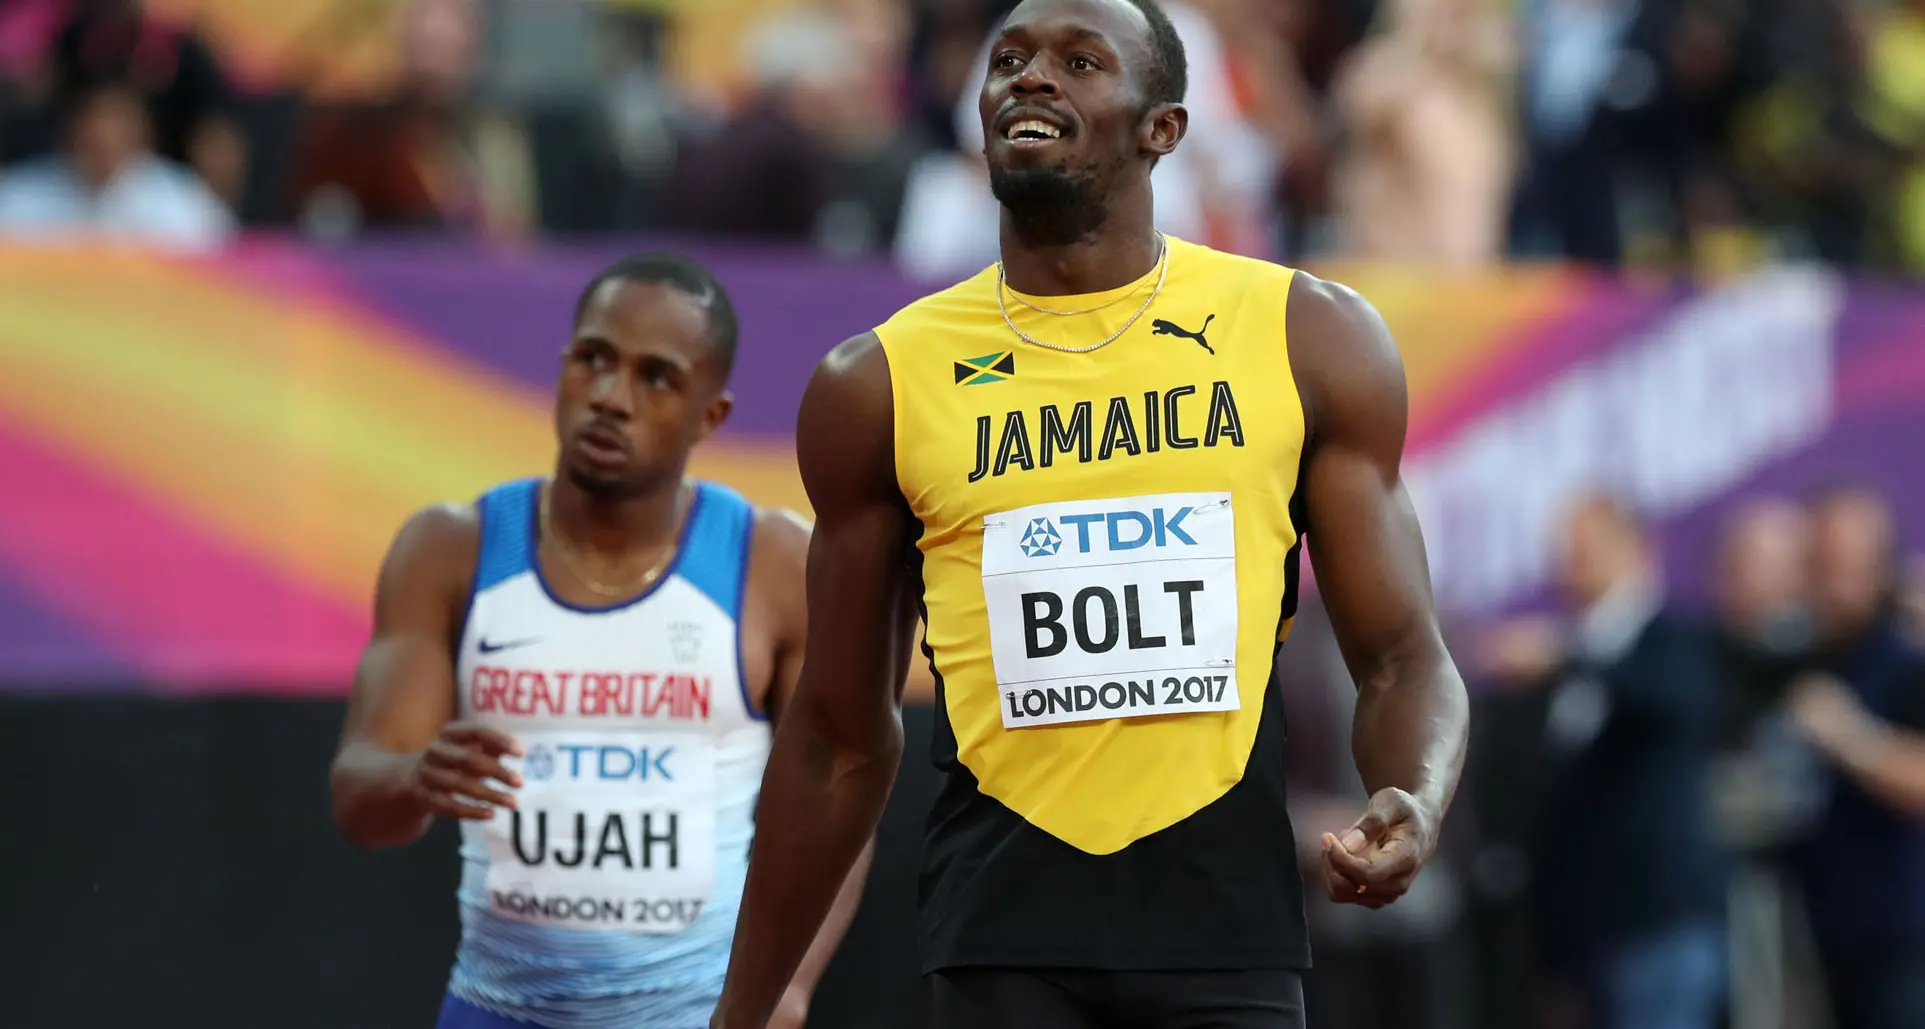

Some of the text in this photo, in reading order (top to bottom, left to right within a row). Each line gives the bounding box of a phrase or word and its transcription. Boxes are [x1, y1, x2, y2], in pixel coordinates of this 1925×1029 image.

[968, 380, 1245, 483] JAMAICA
[1060, 506, 1199, 553] TDK
[1021, 580, 1204, 660] BOLT
[472, 665, 712, 720] GREAT BRITAIN
[1008, 675, 1229, 719] LONDON 2017
[556, 745, 676, 781] TDK
[511, 810, 680, 870] UJAH
[493, 890, 705, 923] LONDON 2017
